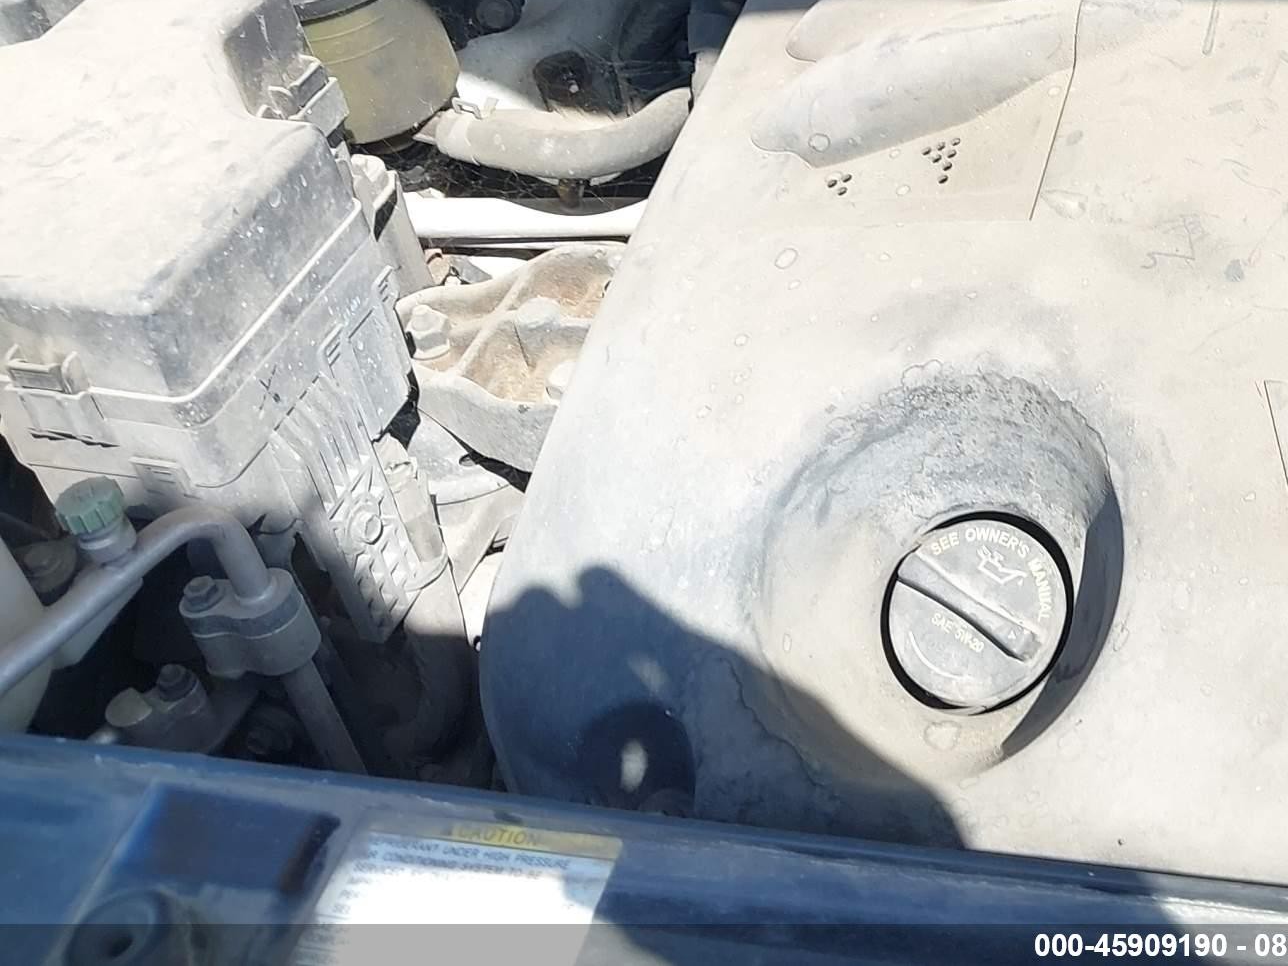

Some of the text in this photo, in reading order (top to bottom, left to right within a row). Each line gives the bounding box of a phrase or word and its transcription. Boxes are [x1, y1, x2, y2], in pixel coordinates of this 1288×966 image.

[931, 527, 1053, 622] SEE OWNER'S MANUAL
[931, 612, 985, 653] SAE 5W-20
[458, 826, 541, 846] CAUTION
[515, 853, 571, 869] PRESSURE
